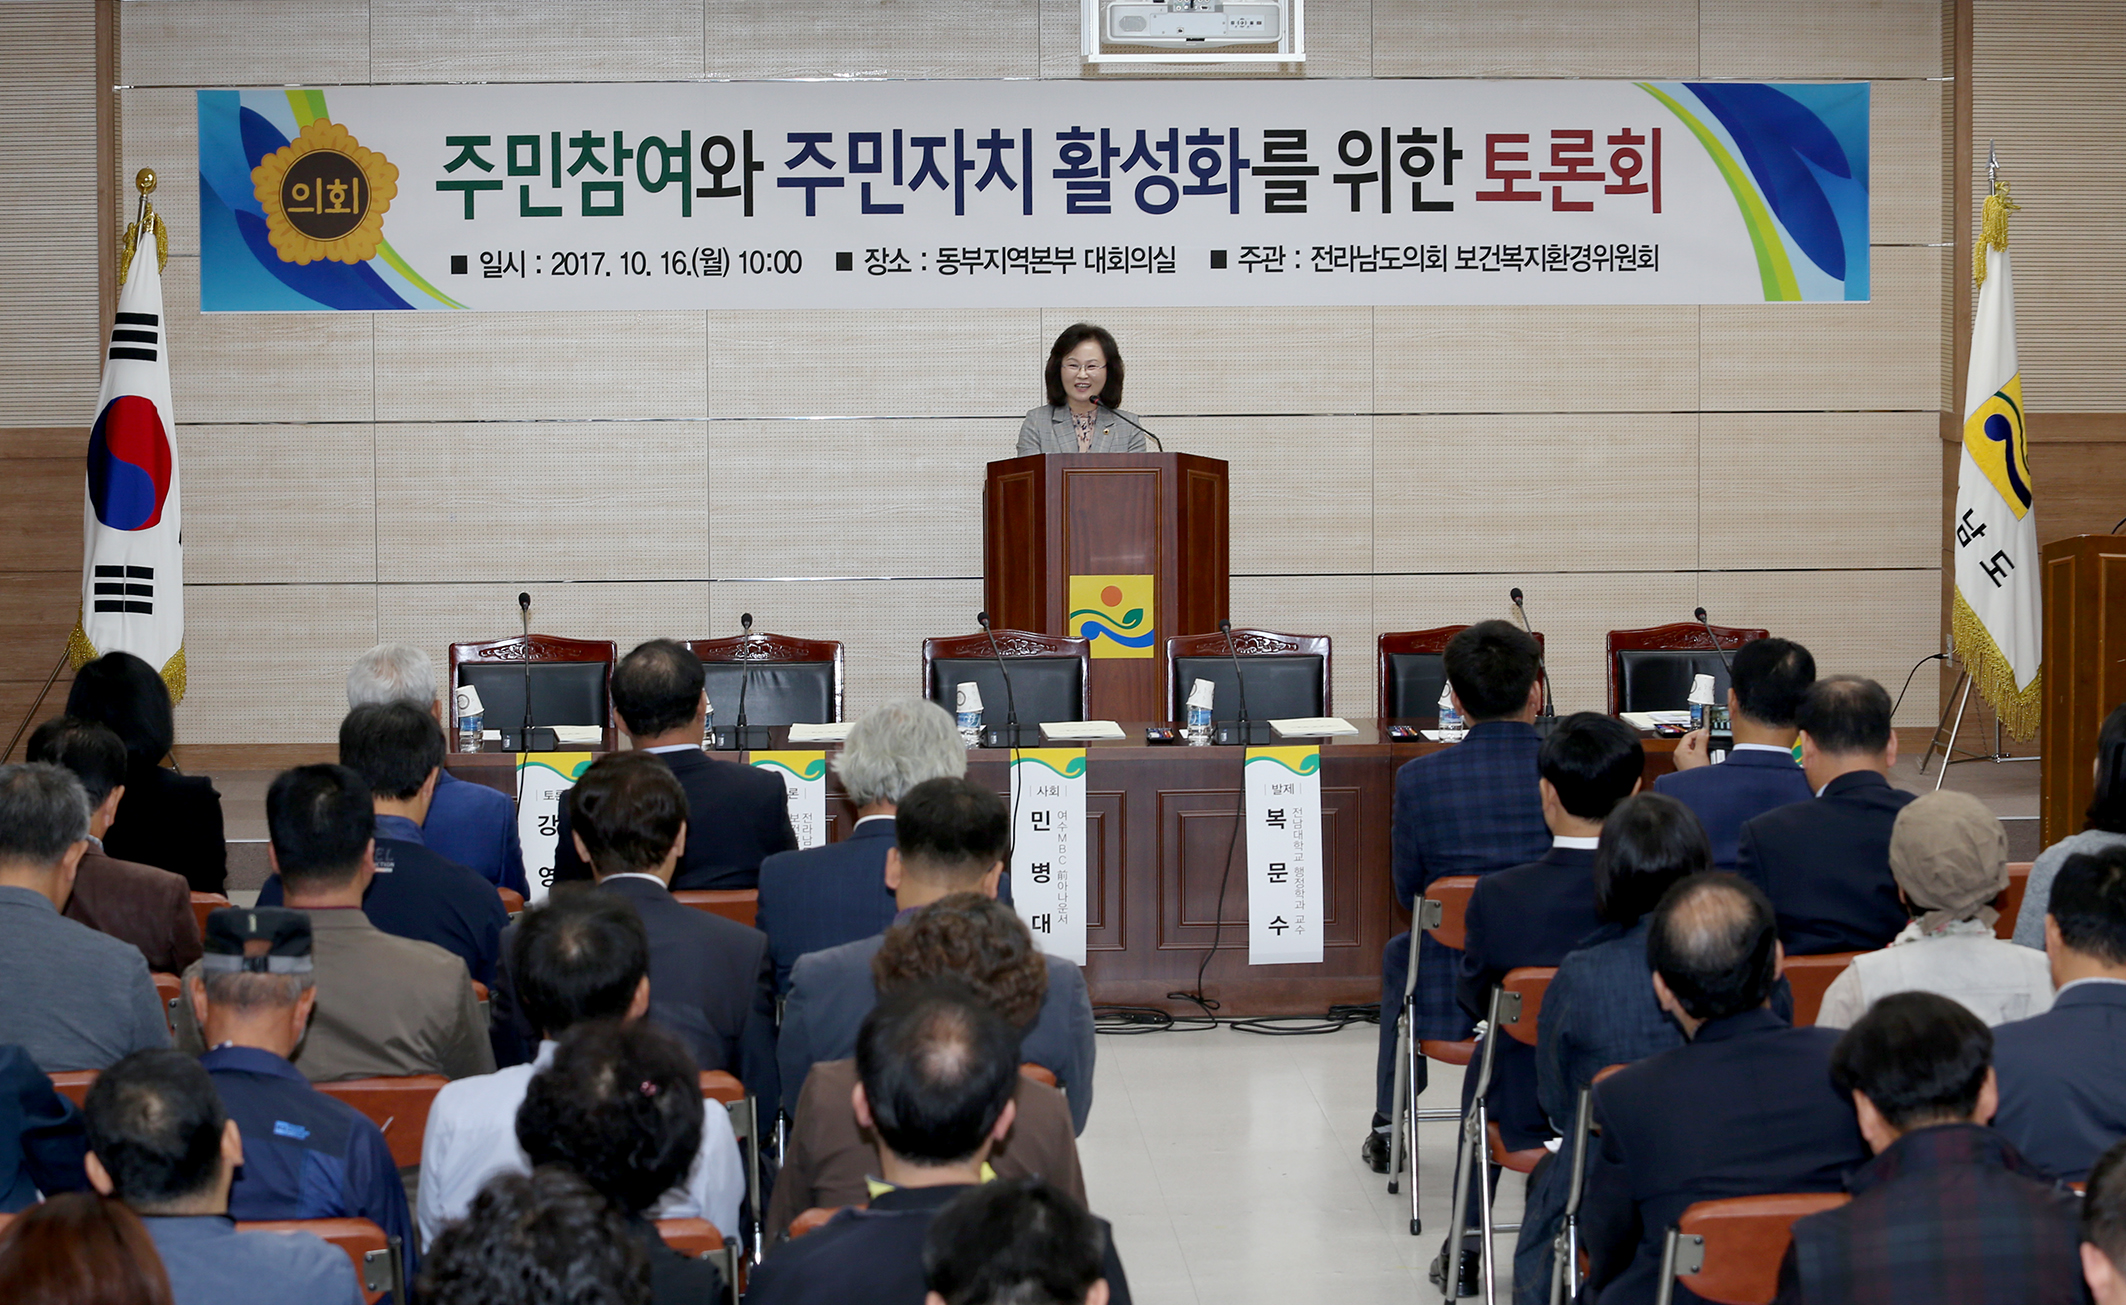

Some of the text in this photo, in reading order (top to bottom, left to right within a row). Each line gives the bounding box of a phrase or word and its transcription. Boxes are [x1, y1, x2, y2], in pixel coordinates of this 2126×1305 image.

[435, 125, 1662, 221] 주민참여와 주민자치 활성화를 위한 토론회
[287, 177, 360, 215] 의회
[479, 249, 526, 279] 일시
[551, 251, 611, 277] 2017.
[620, 250, 652, 277] 10.
[738, 249, 803, 275] 10:00
[864, 247, 912, 276] 장소
[935, 246, 1077, 276] 동부지역본부
[1084, 245, 1176, 275] 대회의실
[1237, 244, 1287, 274] 주관
[1310, 244, 1447, 273] 전라남도의회
[1454, 243, 1659, 273] 보건복지환경위원회
[788, 787, 800, 800] 론
[1036, 785, 1060, 797] 사회
[1271, 782, 1295, 796] 발제
[802, 812, 813, 850] 전라남
[1057, 810, 1068, 865] 여수MBC
[1292, 807, 1306, 935] 전남대학교 행정학과 교수
